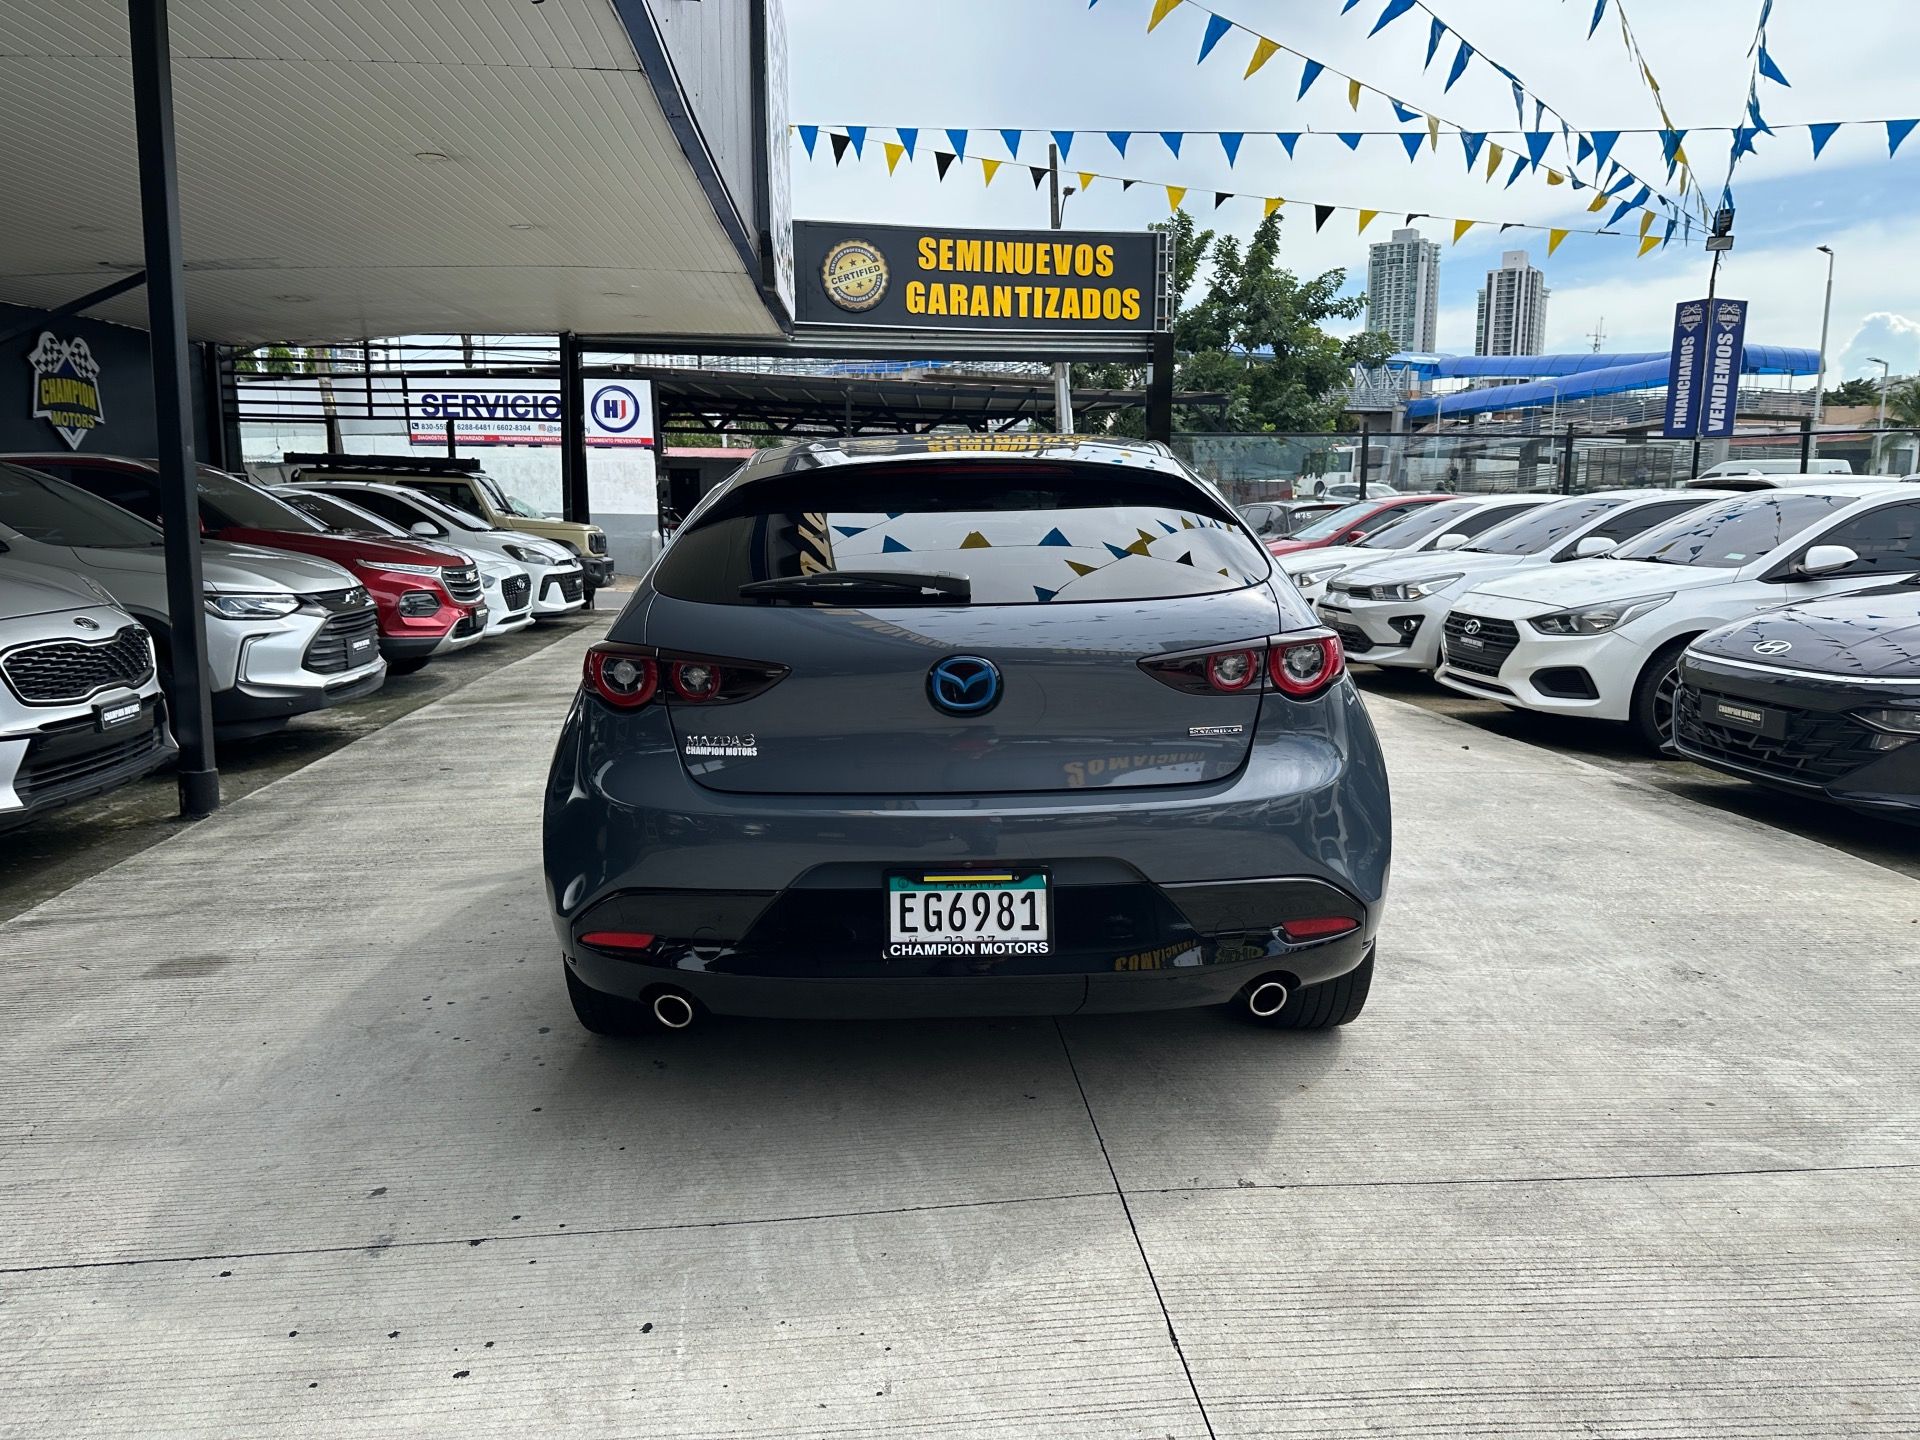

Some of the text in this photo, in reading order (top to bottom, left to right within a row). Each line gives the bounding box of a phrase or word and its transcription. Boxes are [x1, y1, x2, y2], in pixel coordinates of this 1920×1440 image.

[918, 237, 1114, 277] SEMINUEVOS
[831, 264, 881, 285] CERTIFIED
[906, 280, 1141, 320] GARANTIZADOS
[41, 378, 97, 411] CHAMPION
[1673, 336, 1695, 429] FINANCIAMOS
[1708, 333, 1734, 431] VENDEMOS
[51, 411, 96, 429] MOTORS
[421, 393, 561, 419] SERVICIO
[603, 399, 627, 420] HJ
[685, 746, 758, 756] CHAMPION MOTORS
[899, 891, 1040, 933] EG6981
[890, 942, 1049, 956] CHAMPION MOTORS
